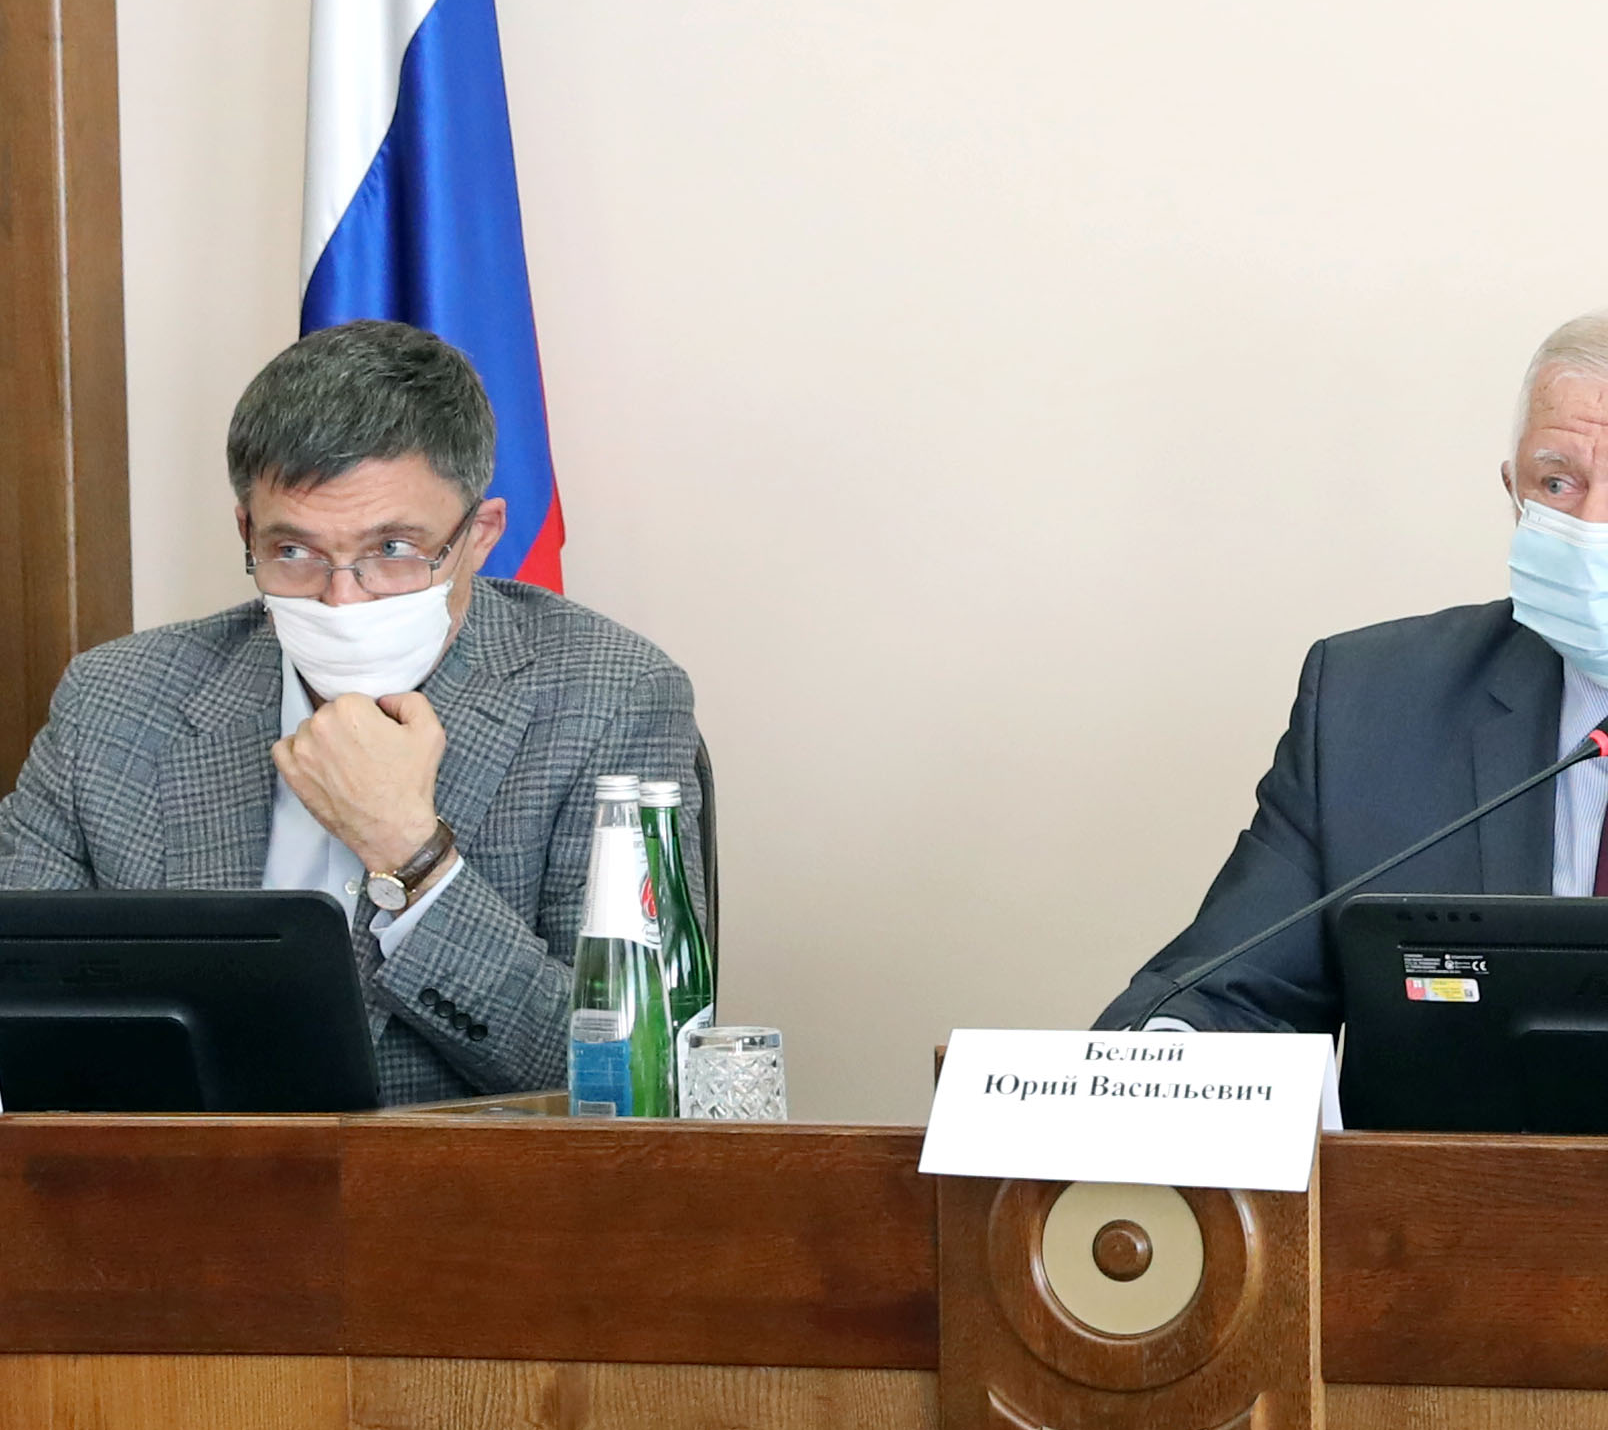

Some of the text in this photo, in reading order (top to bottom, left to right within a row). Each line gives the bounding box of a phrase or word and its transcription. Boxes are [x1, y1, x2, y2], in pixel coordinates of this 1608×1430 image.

[1085, 1041, 1185, 1062] Белый
[984, 1073, 1273, 1101] Юрий Васильевич
